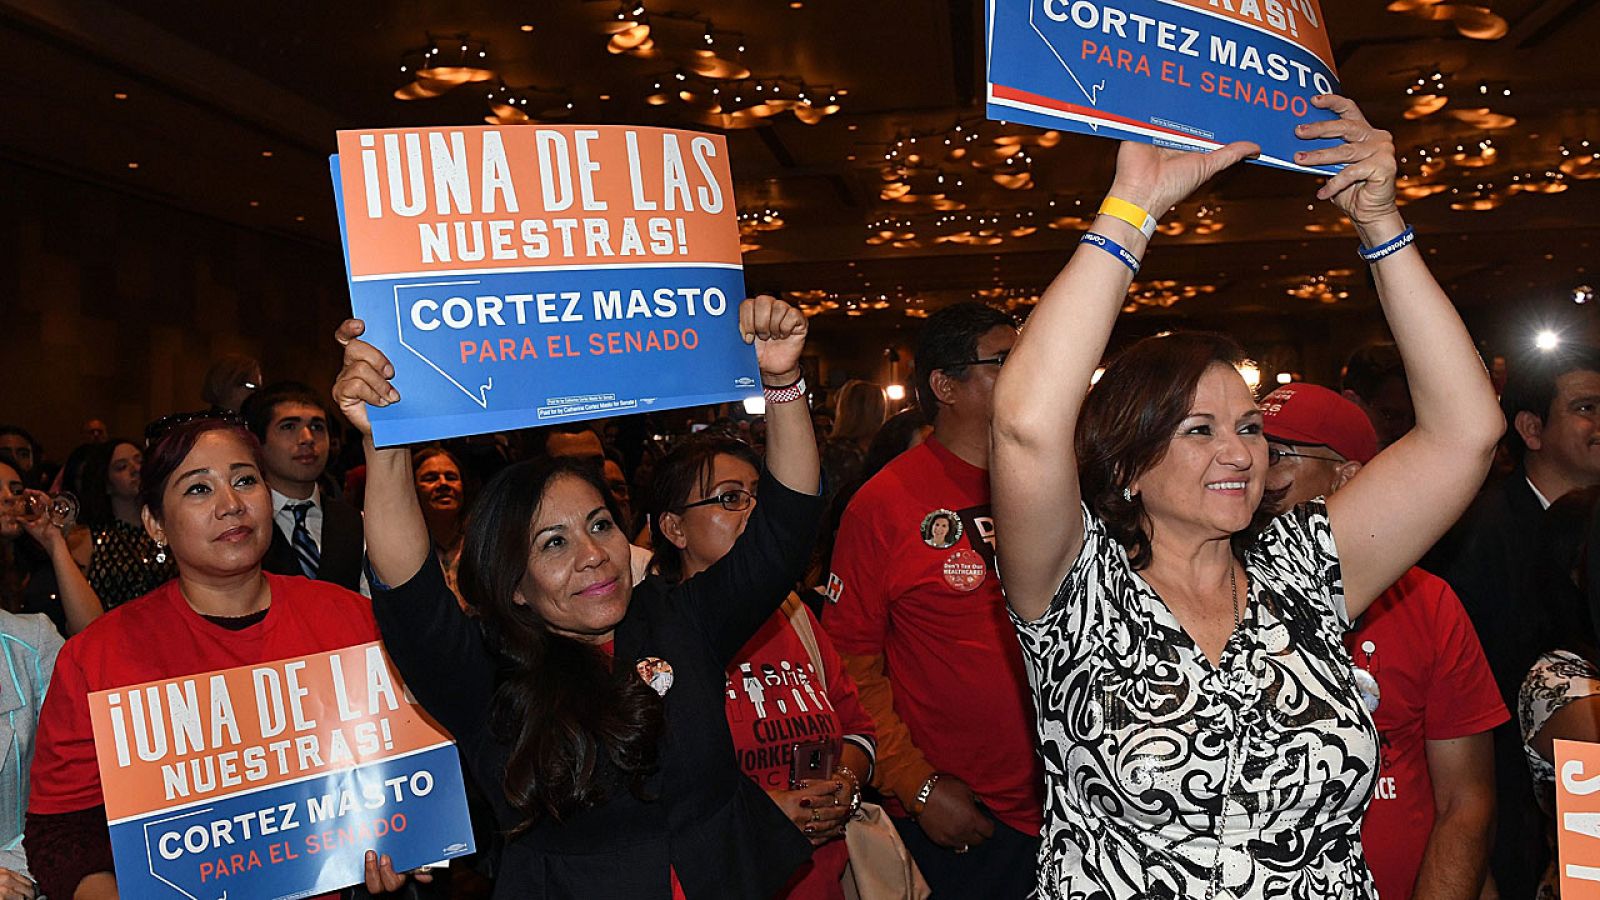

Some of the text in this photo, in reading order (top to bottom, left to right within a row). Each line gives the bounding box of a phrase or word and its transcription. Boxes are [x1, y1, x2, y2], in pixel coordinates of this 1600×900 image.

[1043, 0, 1333, 95] CORTEZ MASTO
[1081, 40, 1308, 117] PARA EL SENADO
[535, 129, 609, 212] DE
[625, 130, 725, 215] LAS
[418, 217, 689, 264] NUESTRAS!
[410, 287, 727, 331] CORTEZ MASTO
[459, 328, 699, 365] PARA EL SENADO
[251, 660, 317, 739] DE
[329, 645, 416, 723] LA
[753, 713, 836, 744] CULINARY
[161, 722, 394, 801] NUESTRAS!
[158, 770, 435, 860] CORTEZ MASTO
[200, 812, 408, 883] PARA EL SENADO
